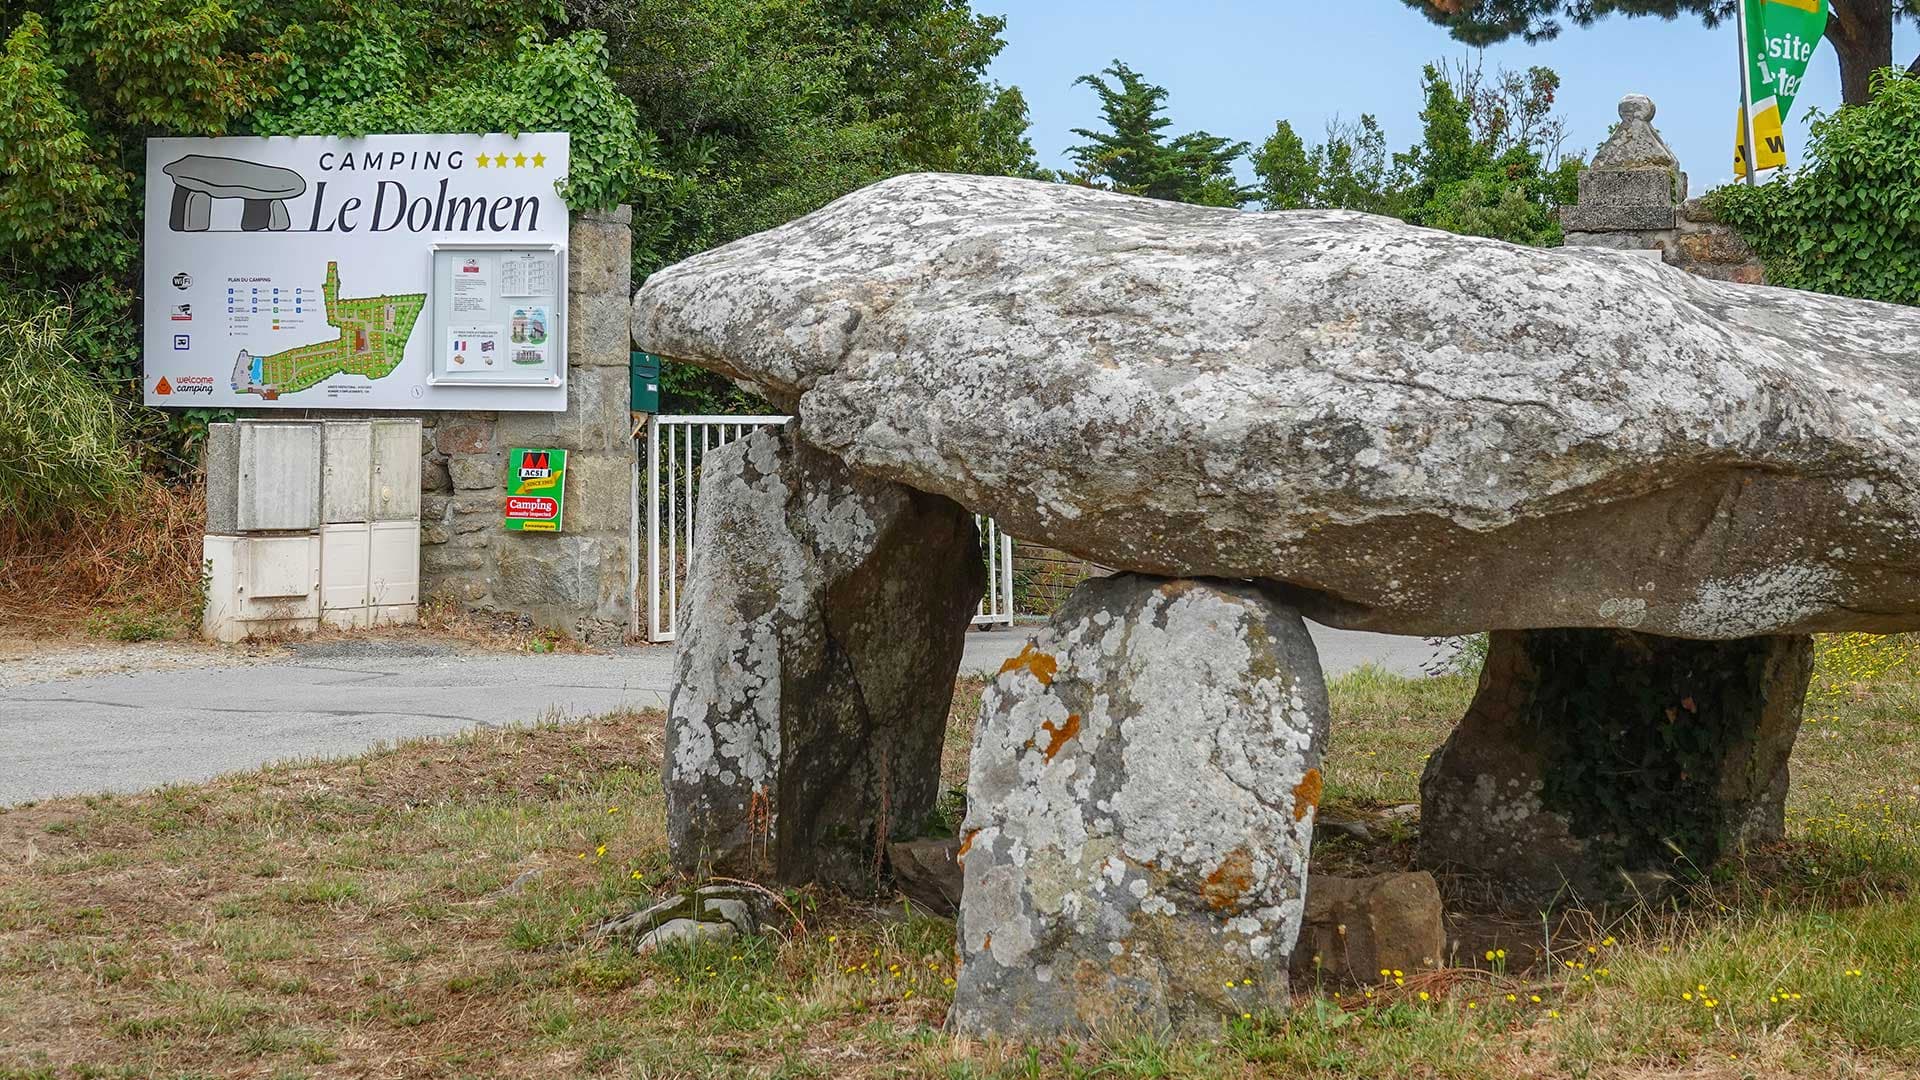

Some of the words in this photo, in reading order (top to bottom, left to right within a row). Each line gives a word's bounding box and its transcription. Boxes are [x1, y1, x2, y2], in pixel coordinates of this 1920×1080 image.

[319, 150, 464, 171] CAMPING
[309, 180, 361, 233] Le
[369, 177, 539, 233] Dolmen
[176, 375, 214, 385] welcome
[176, 385, 214, 396] camping
[509, 498, 553, 512] Camping
